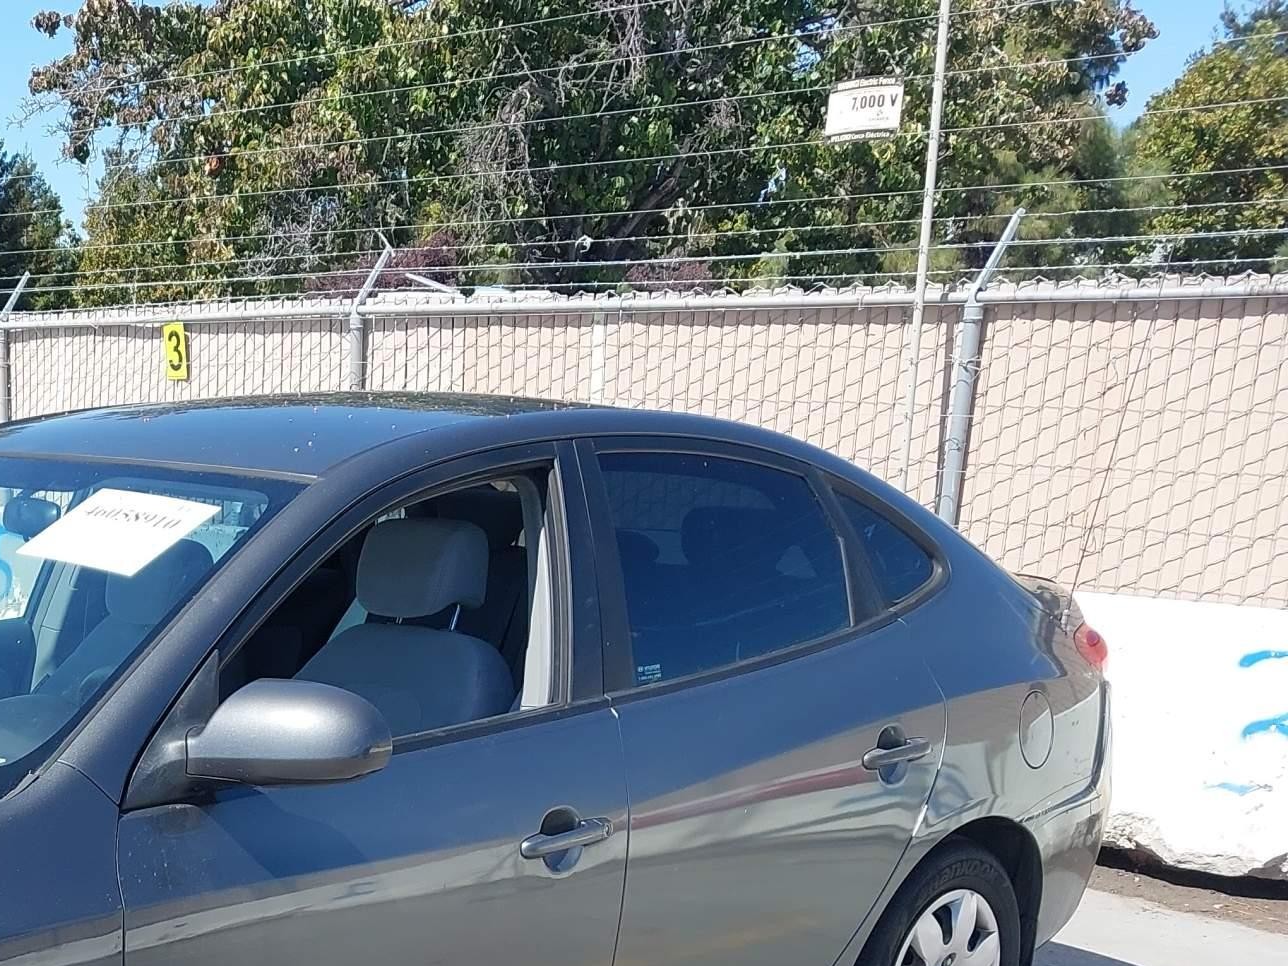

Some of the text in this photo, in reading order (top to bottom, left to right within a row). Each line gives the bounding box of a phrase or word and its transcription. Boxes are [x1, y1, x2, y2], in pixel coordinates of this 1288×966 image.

[852, 93, 899, 112] 7,000 V
[167, 330, 183, 371] 3
